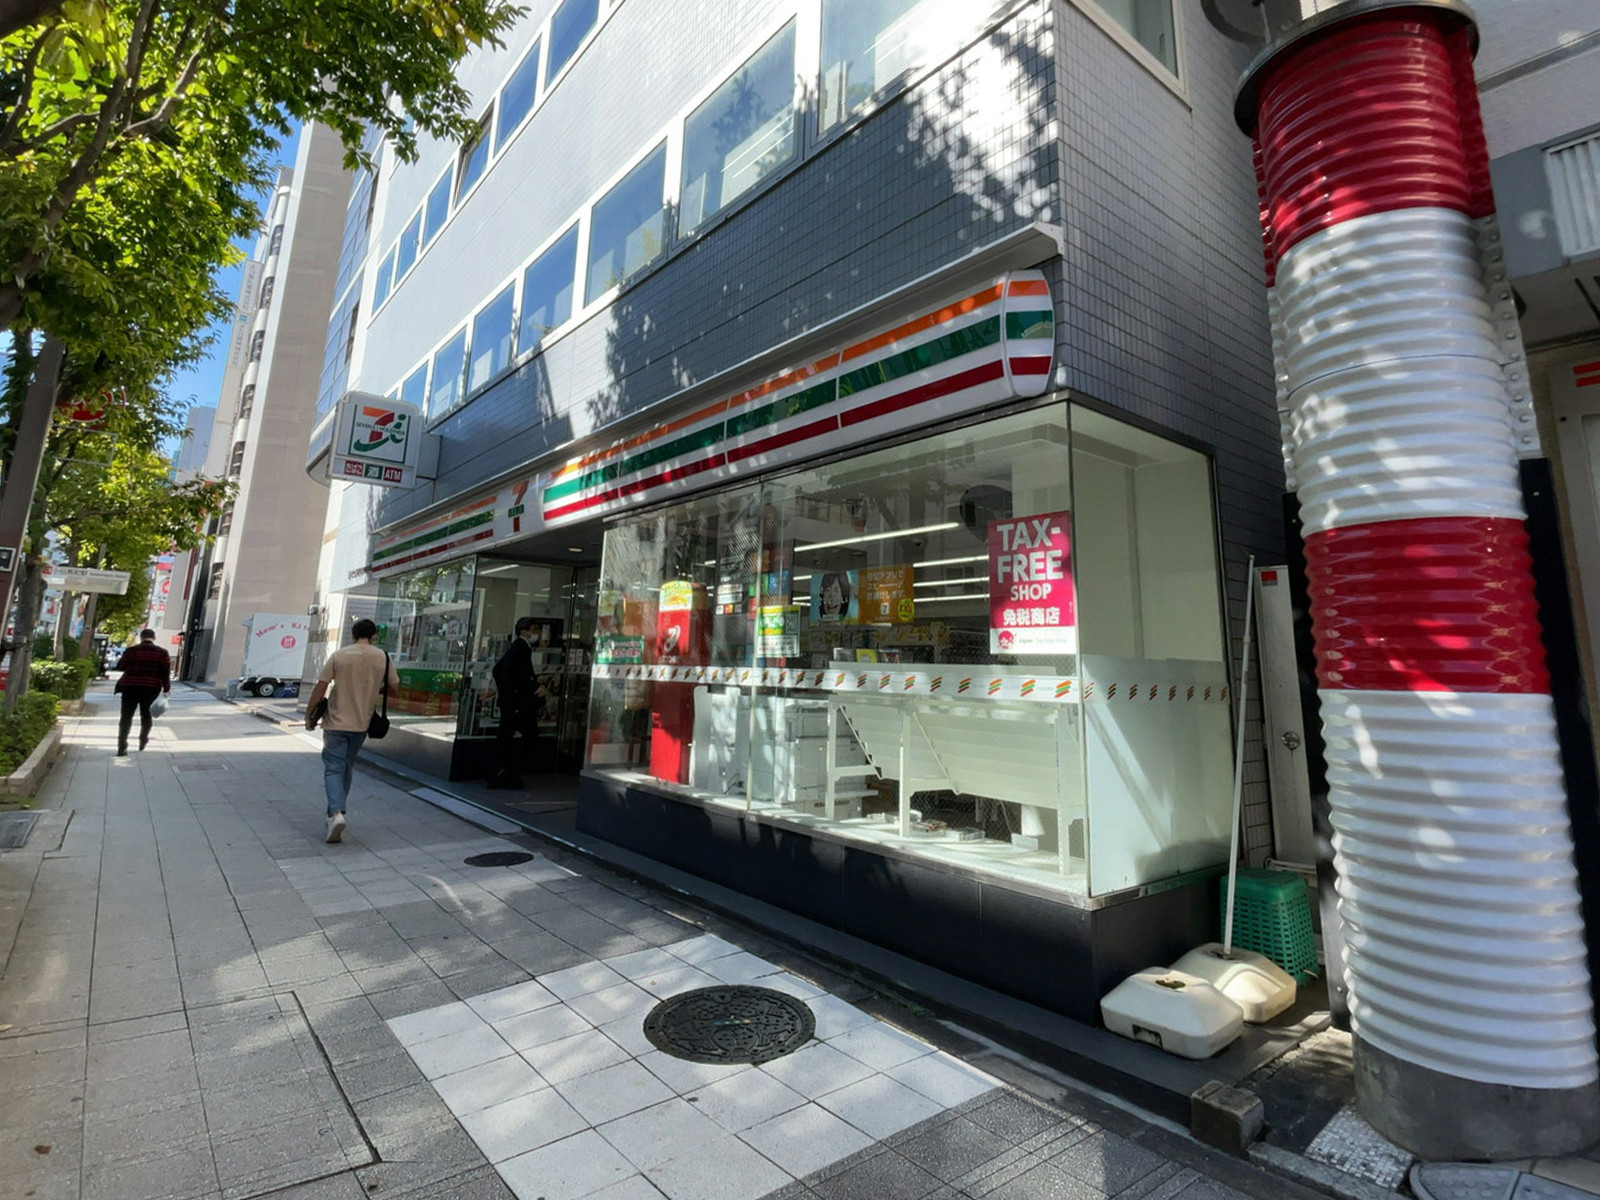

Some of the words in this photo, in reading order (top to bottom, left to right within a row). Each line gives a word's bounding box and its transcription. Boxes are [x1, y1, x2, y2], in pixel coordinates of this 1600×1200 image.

[384, 468, 401, 481] ATM
[996, 517, 1061, 551] TAX-
[997, 550, 1063, 583] FREE
[1010, 583, 1052, 601] SHOP
[1002, 607, 1060, 625] 免税商店
